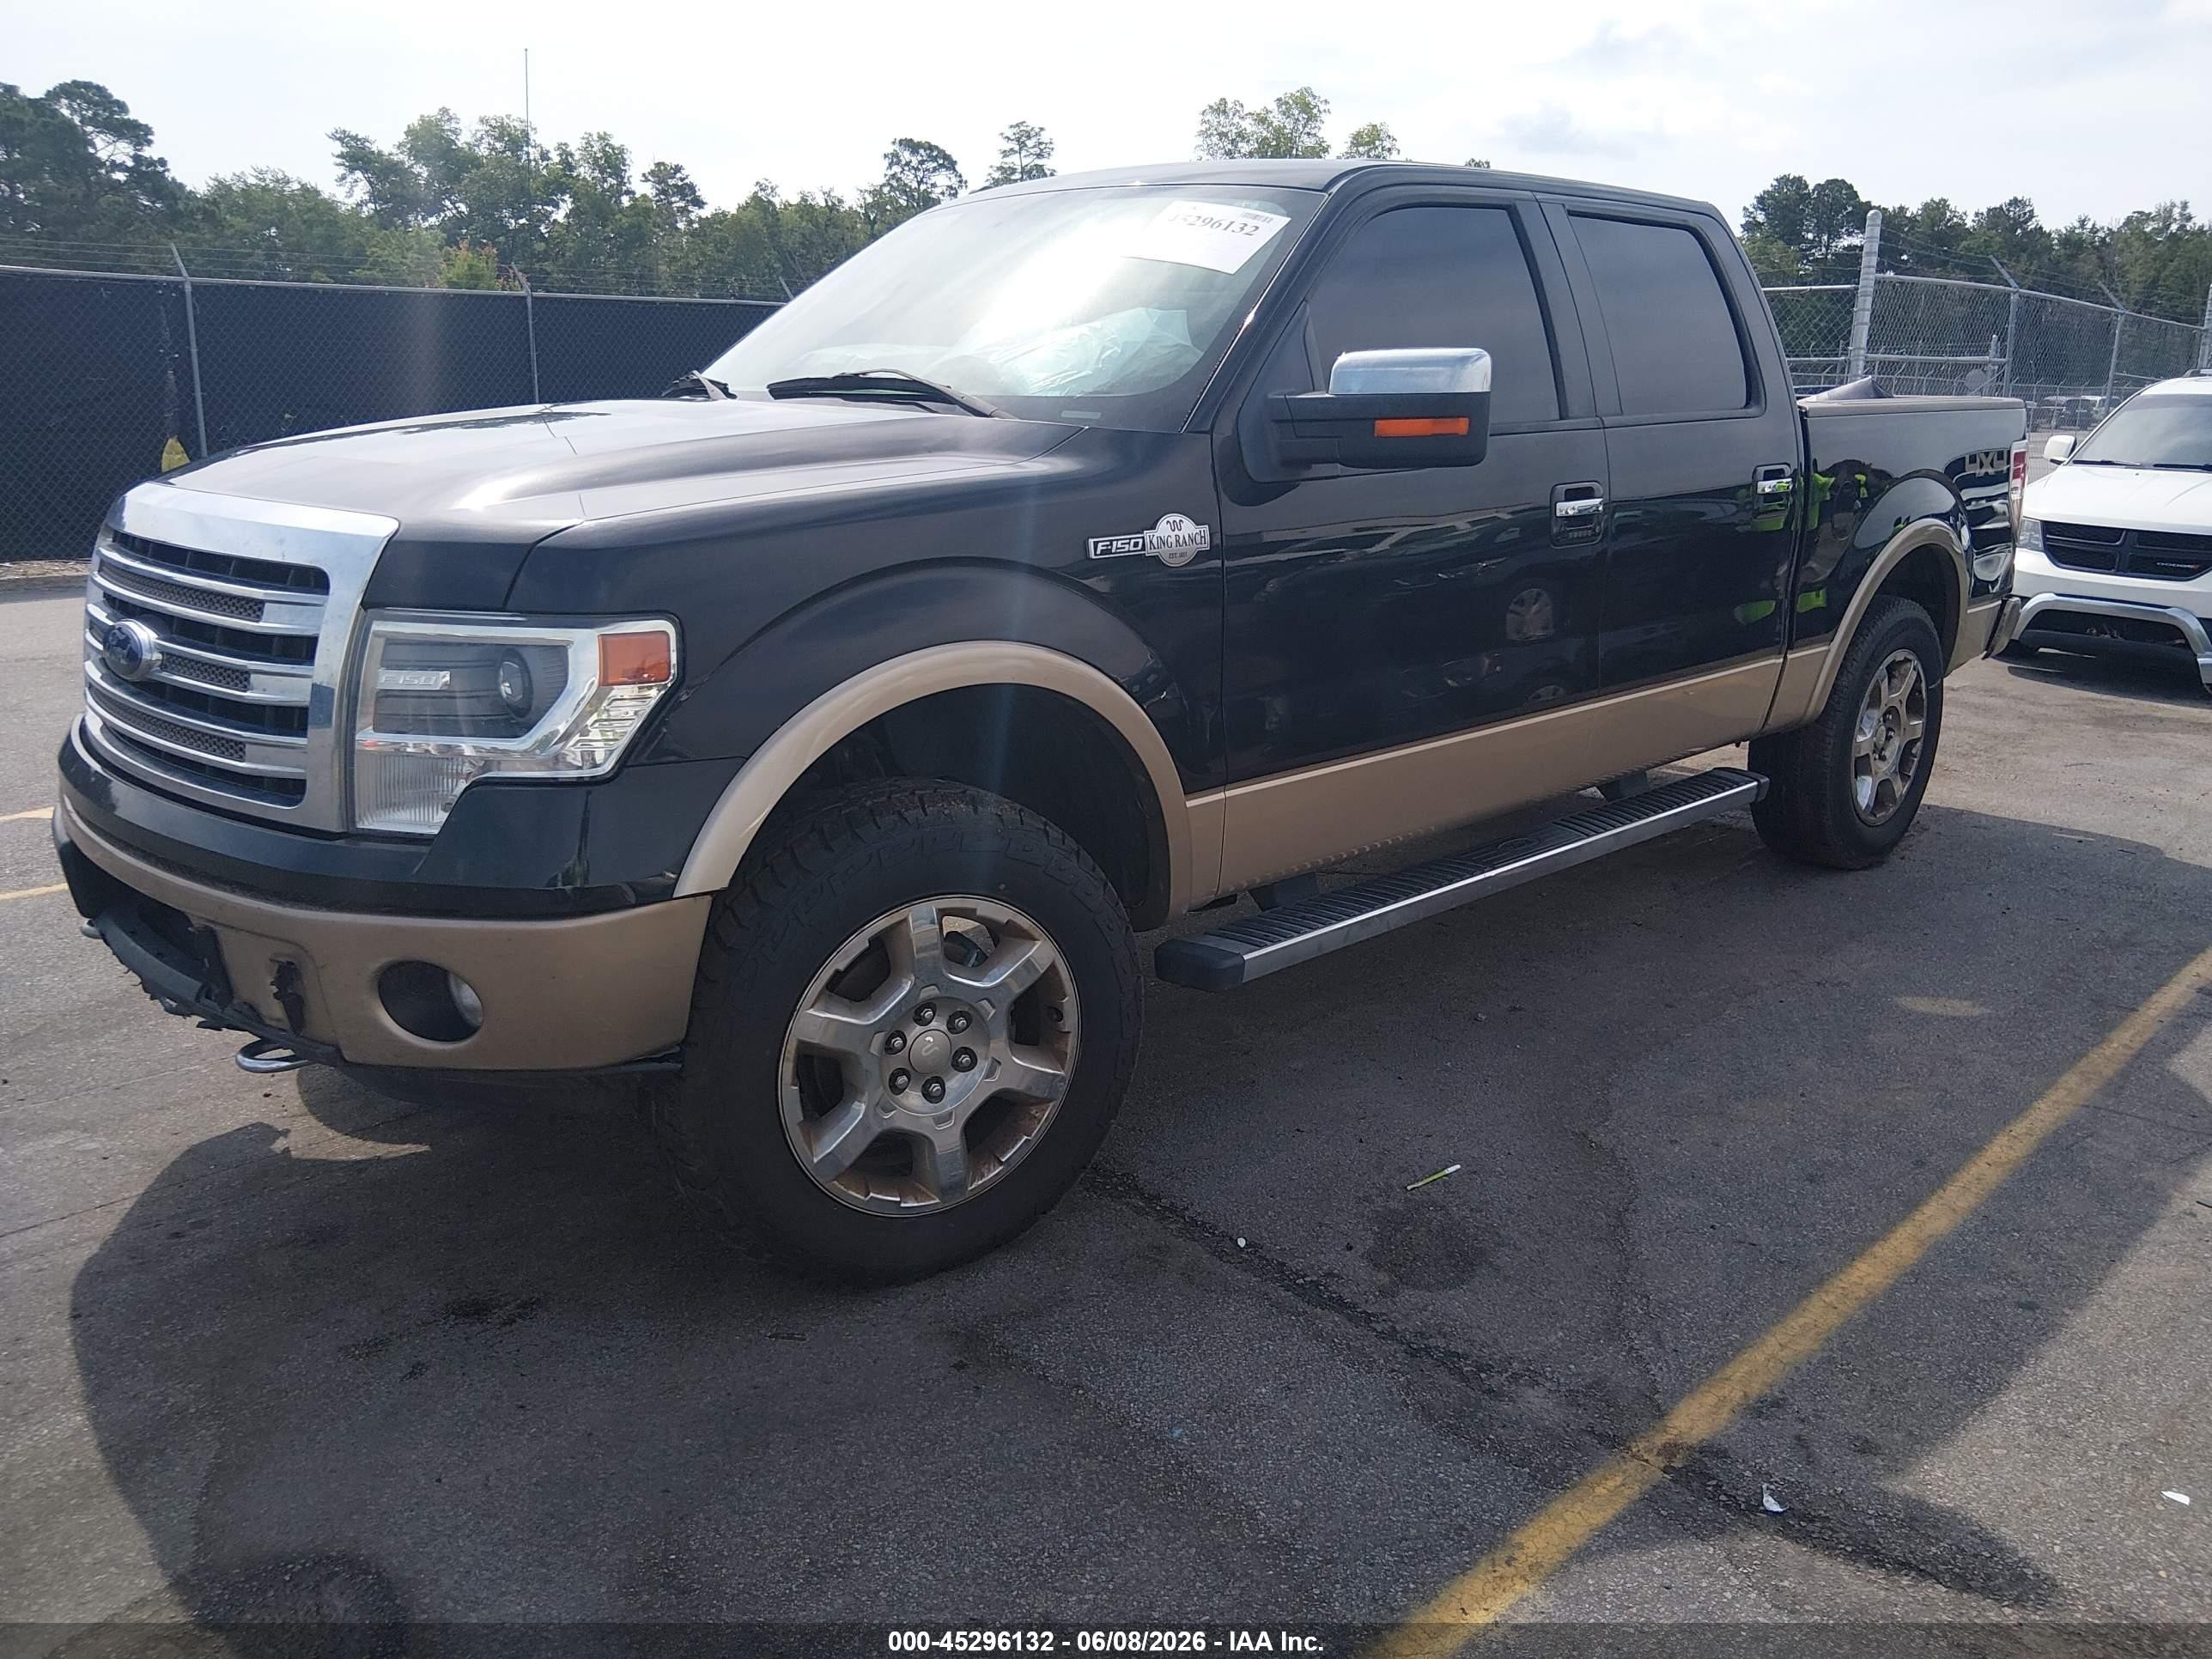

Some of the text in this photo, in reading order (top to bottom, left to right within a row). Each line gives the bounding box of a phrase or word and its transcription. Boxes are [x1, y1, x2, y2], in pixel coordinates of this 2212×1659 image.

[1167, 214, 1260, 236] 296132
[1096, 538, 1143, 555] F-150
[1148, 530, 1206, 550] KING RANCH
